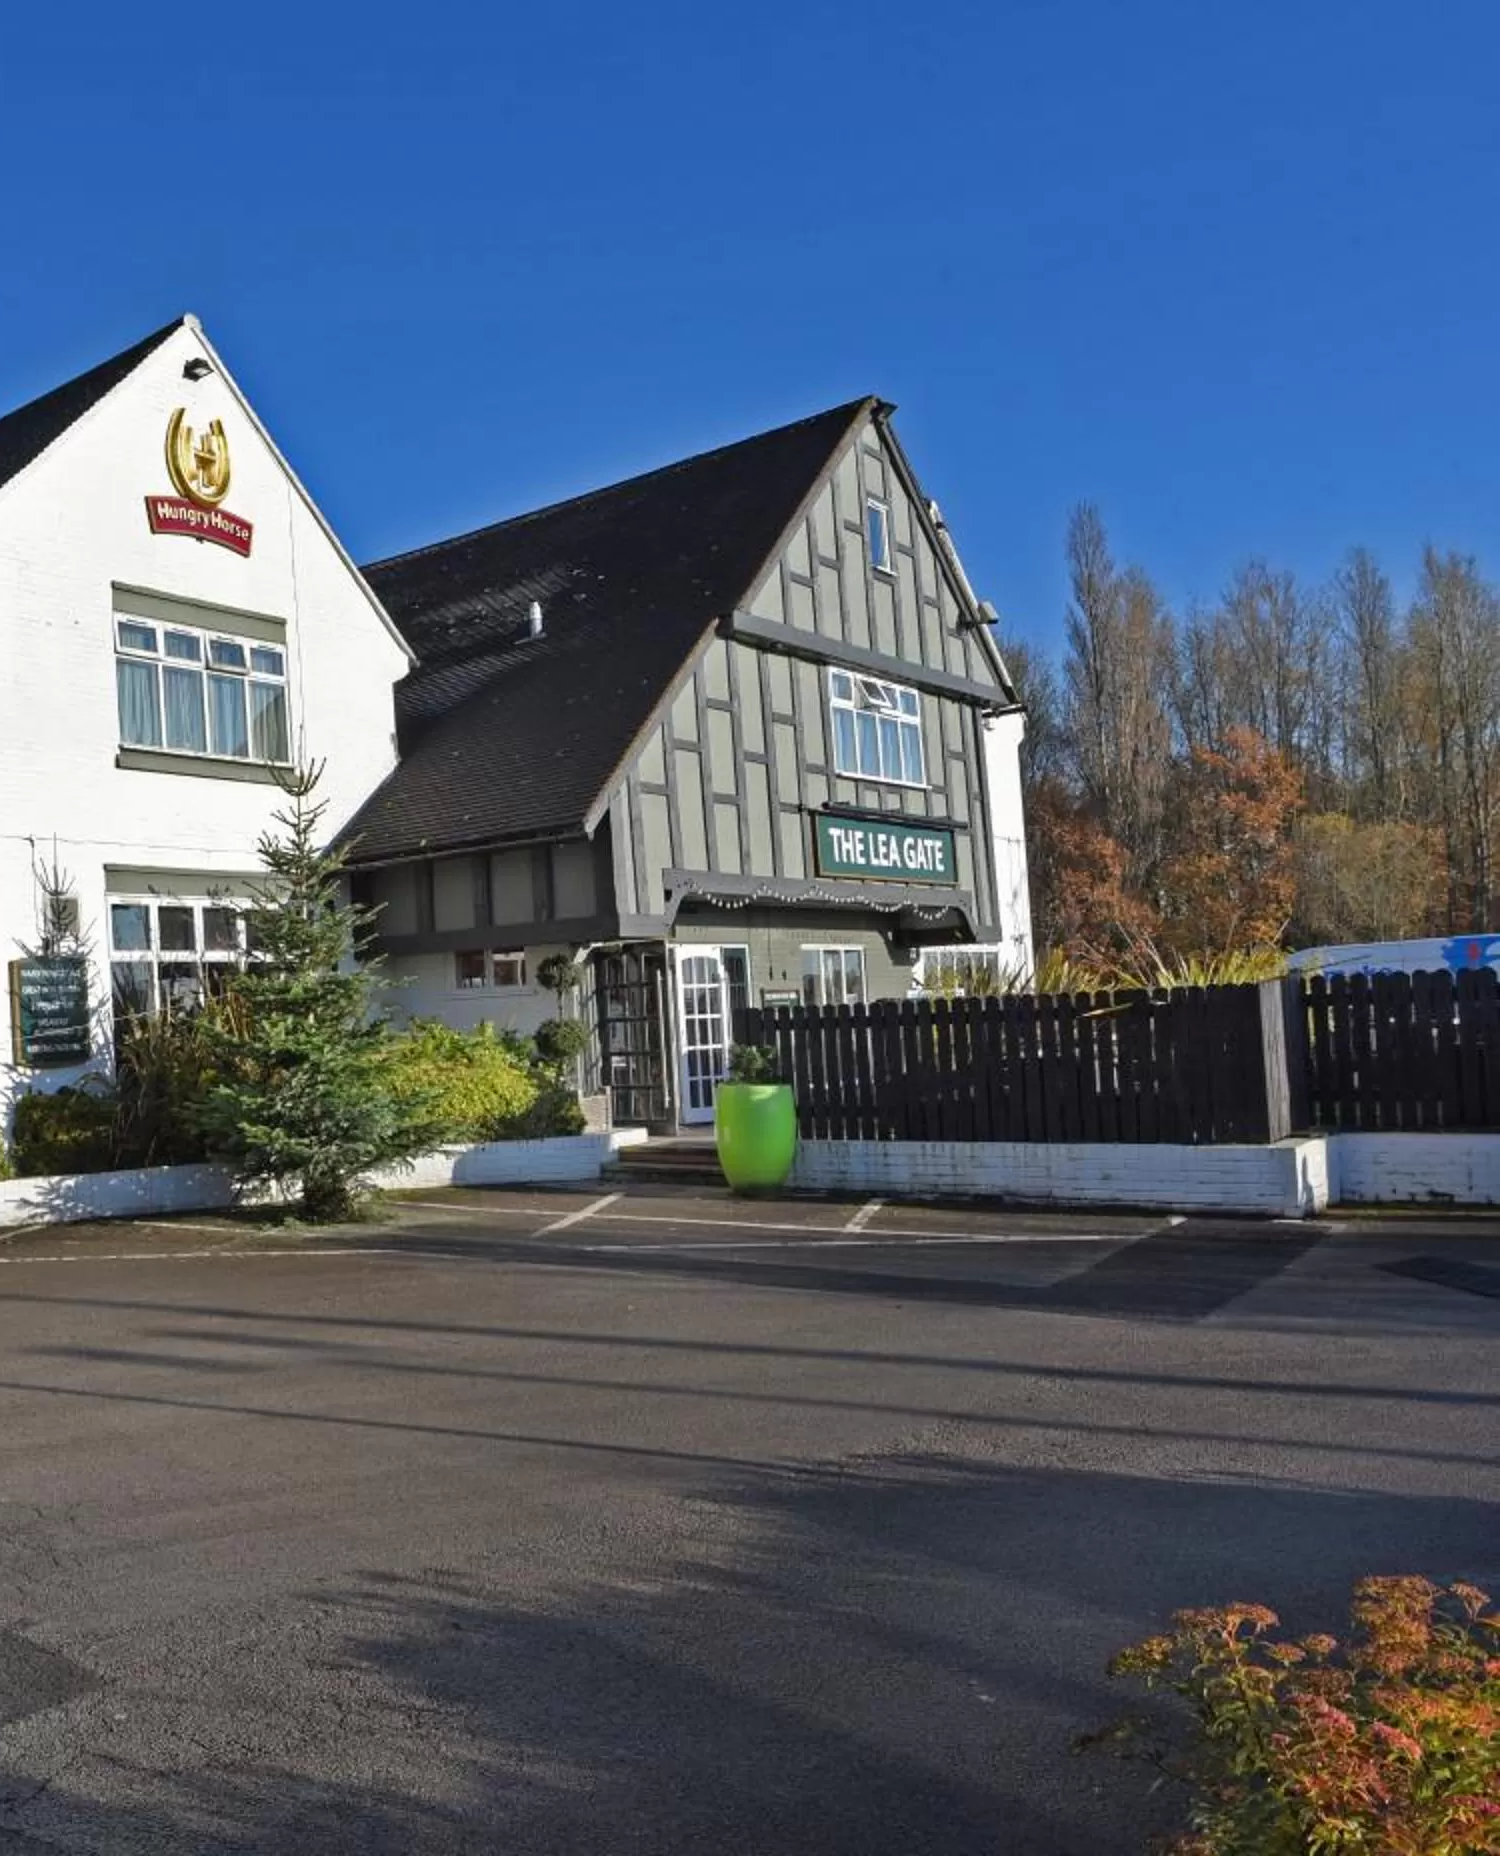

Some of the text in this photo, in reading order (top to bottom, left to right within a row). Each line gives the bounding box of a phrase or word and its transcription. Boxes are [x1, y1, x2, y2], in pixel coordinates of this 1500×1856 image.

[157, 503, 249, 540] Hungry Horse
[828, 827, 945, 872] THE LEA GATE
